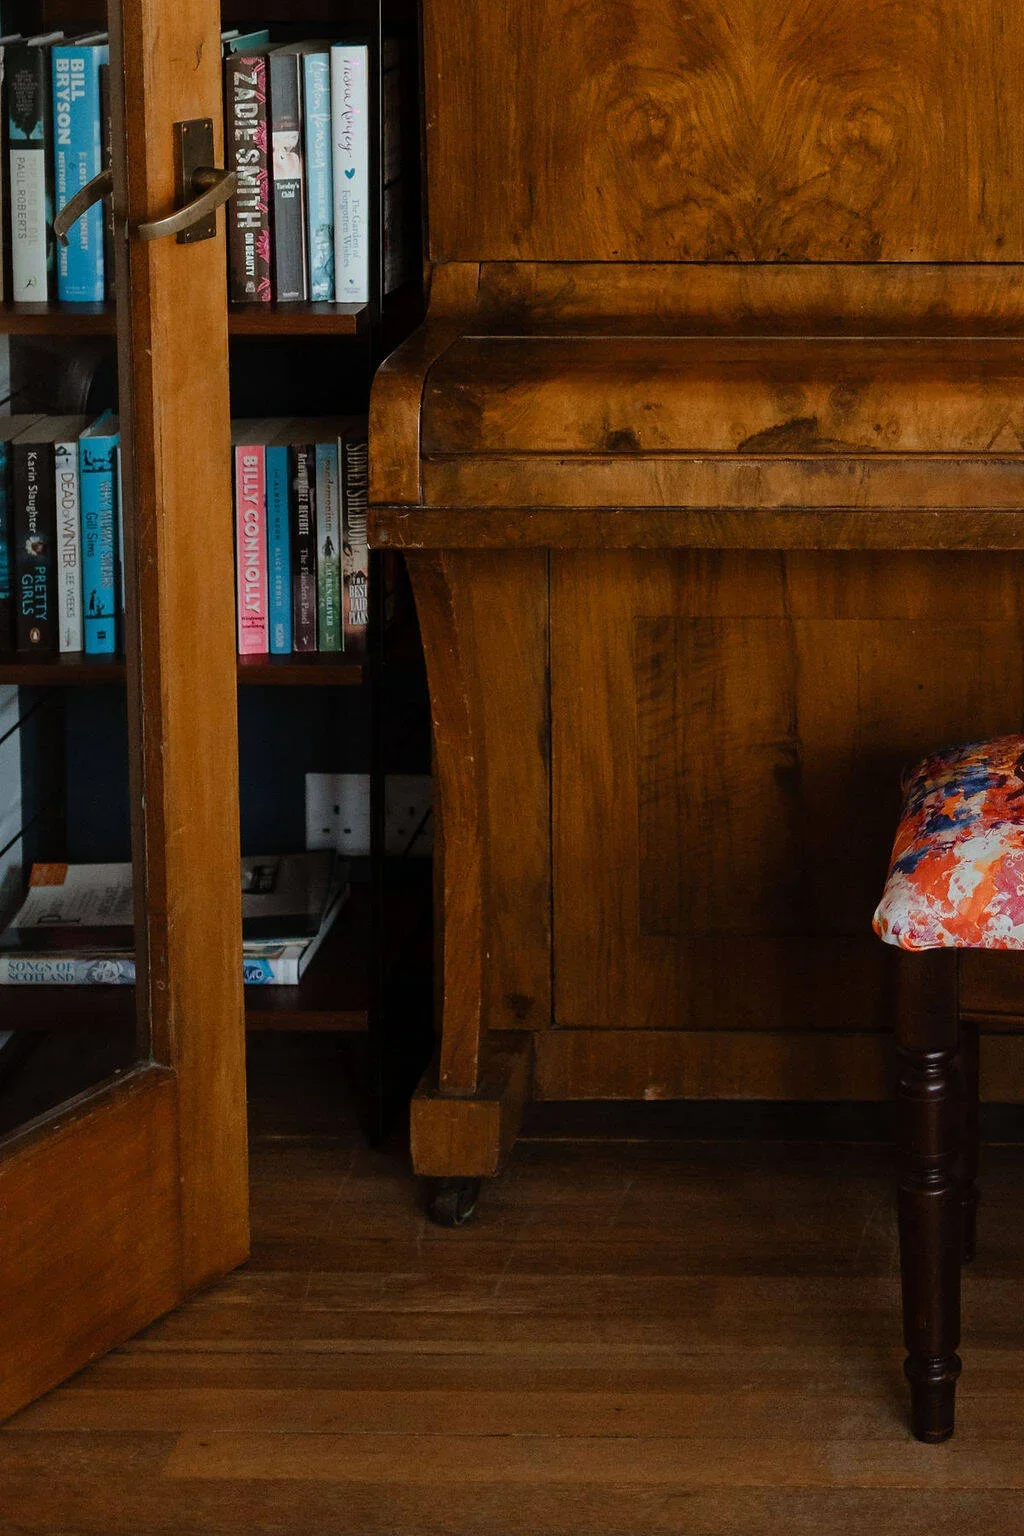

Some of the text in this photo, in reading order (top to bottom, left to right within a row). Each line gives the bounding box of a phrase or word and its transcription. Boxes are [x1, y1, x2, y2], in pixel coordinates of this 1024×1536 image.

[56, 58, 71, 144] BRYSON
[71, 58, 86, 101] BILL
[309, 60, 329, 112] Gordon
[233, 71, 262, 229] ZADIE SMITH
[309, 113, 331, 169] Ramsay
[338, 104, 361, 158] Ashley
[79, 162, 87, 186] LOST
[16, 157, 27, 240] PAUL ROBERTS
[351, 199, 360, 215] The
[341, 190, 352, 267] Forgotten Wishes
[351, 216, 360, 249] Garden
[244, 232, 255, 276] ON BEAUTY
[24, 452, 39, 534] Karin Slaughter
[60, 472, 75, 509] DEAD
[100, 480, 112, 506] WHY
[346, 443, 368, 545] SIDNEY SHELDON
[62, 519, 77, 567] WINTER
[85, 512, 98, 557] Gill Sims
[100, 509, 113, 548] MUMMY
[242, 455, 262, 614] BILLY CONNOLLY
[21, 573, 34, 616] GIRLS
[33, 566, 48, 621] PRETTY
[66, 572, 75, 586] LEE
[300, 548, 309, 625] The Flanders Panel
[349, 585, 367, 598] BEST
[66, 587, 75, 618] WEEKS
[325, 596, 334, 627] OLIVER
[350, 598, 367, 611] LAID
[8, 961, 72, 972] SONGS OF
[8, 972, 74, 982] SCOTLAND
